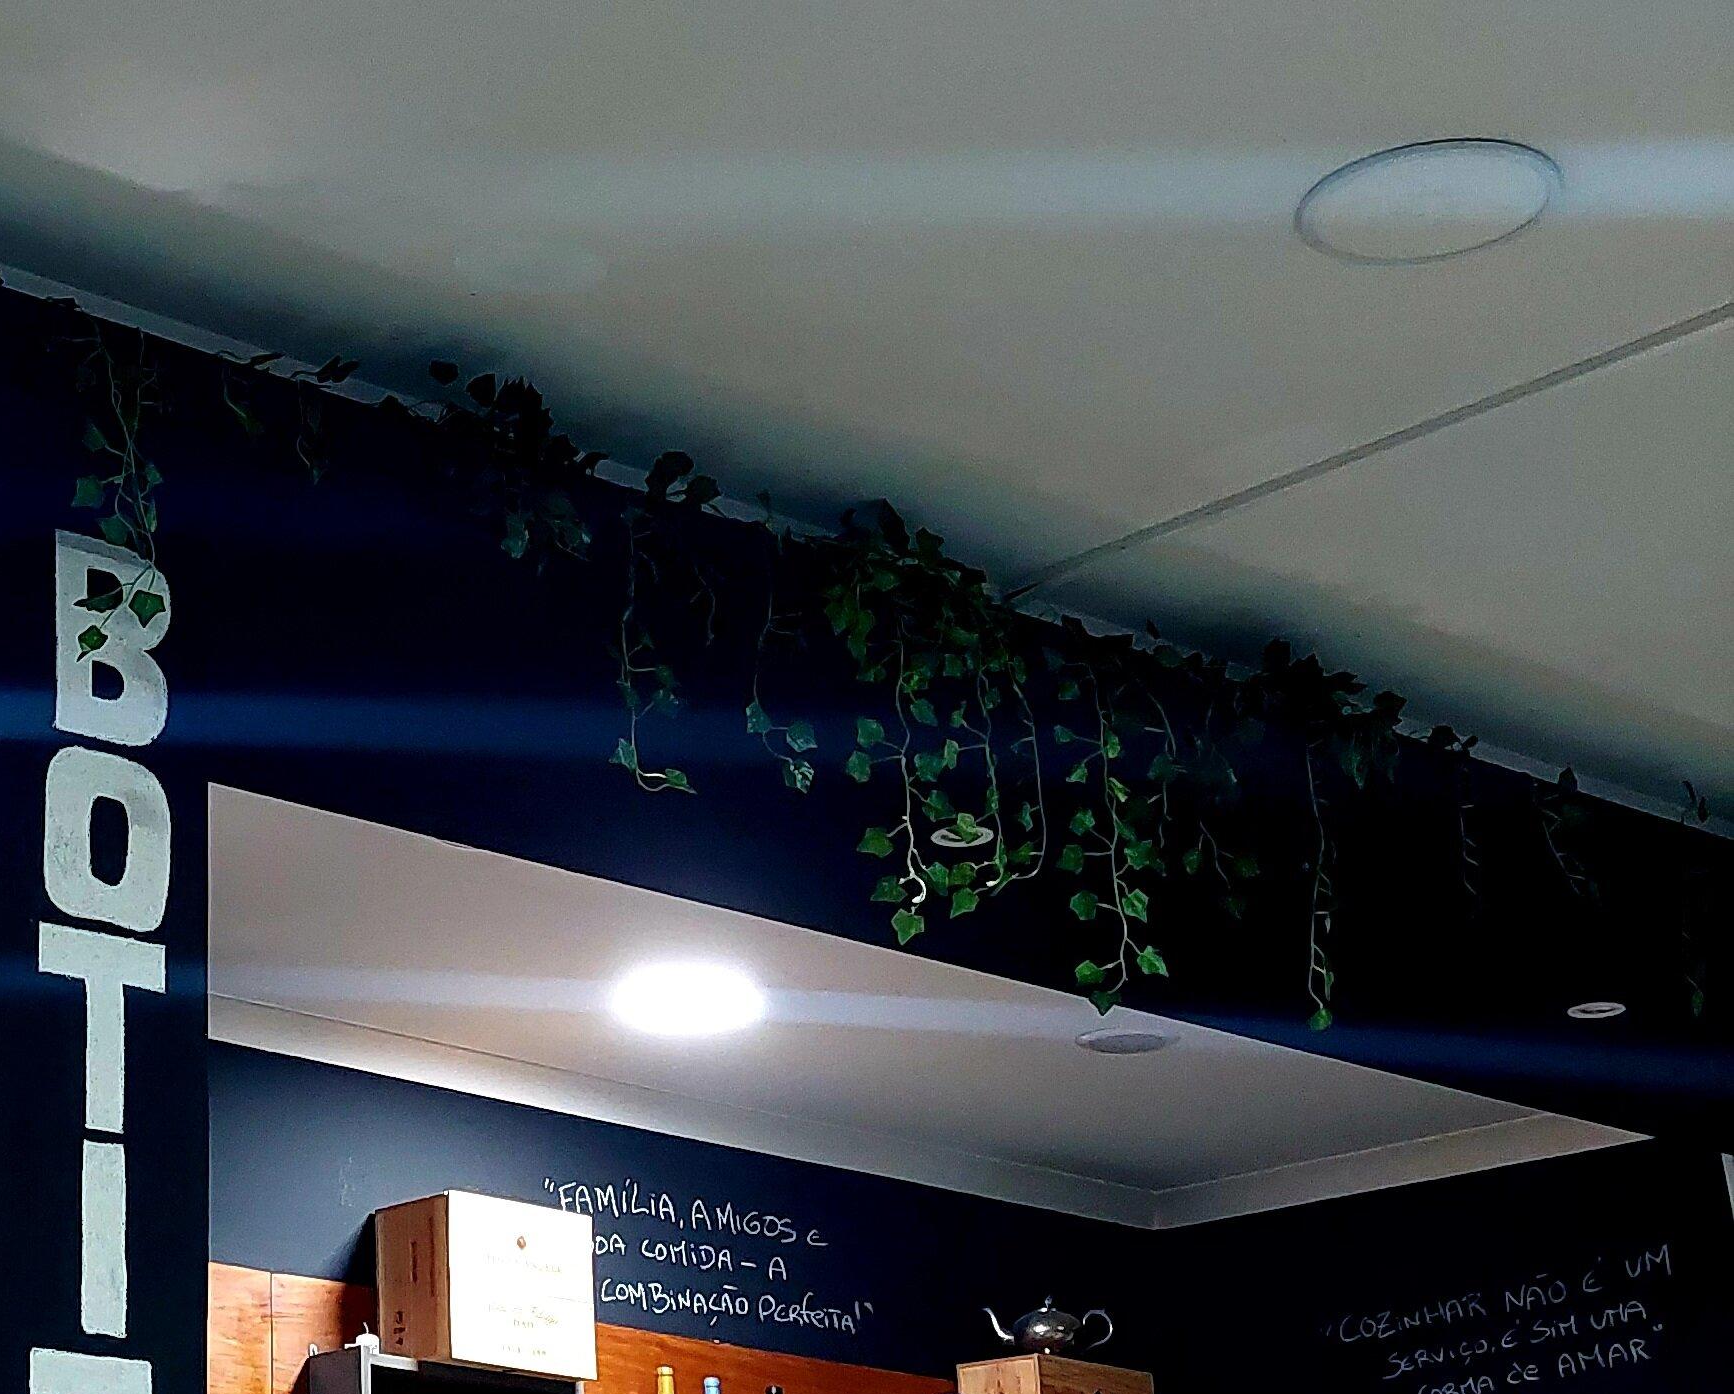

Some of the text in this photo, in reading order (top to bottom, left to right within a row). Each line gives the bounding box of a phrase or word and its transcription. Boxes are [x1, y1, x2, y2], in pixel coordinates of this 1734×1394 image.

[692, 1199, 797, 1244] AMIGOS
[768, 1257, 787, 1281] A
[1505, 1272, 1567, 1311] NÃO
[1625, 1244, 1672, 1279] UM
[1590, 1301, 1647, 1331] UMA
